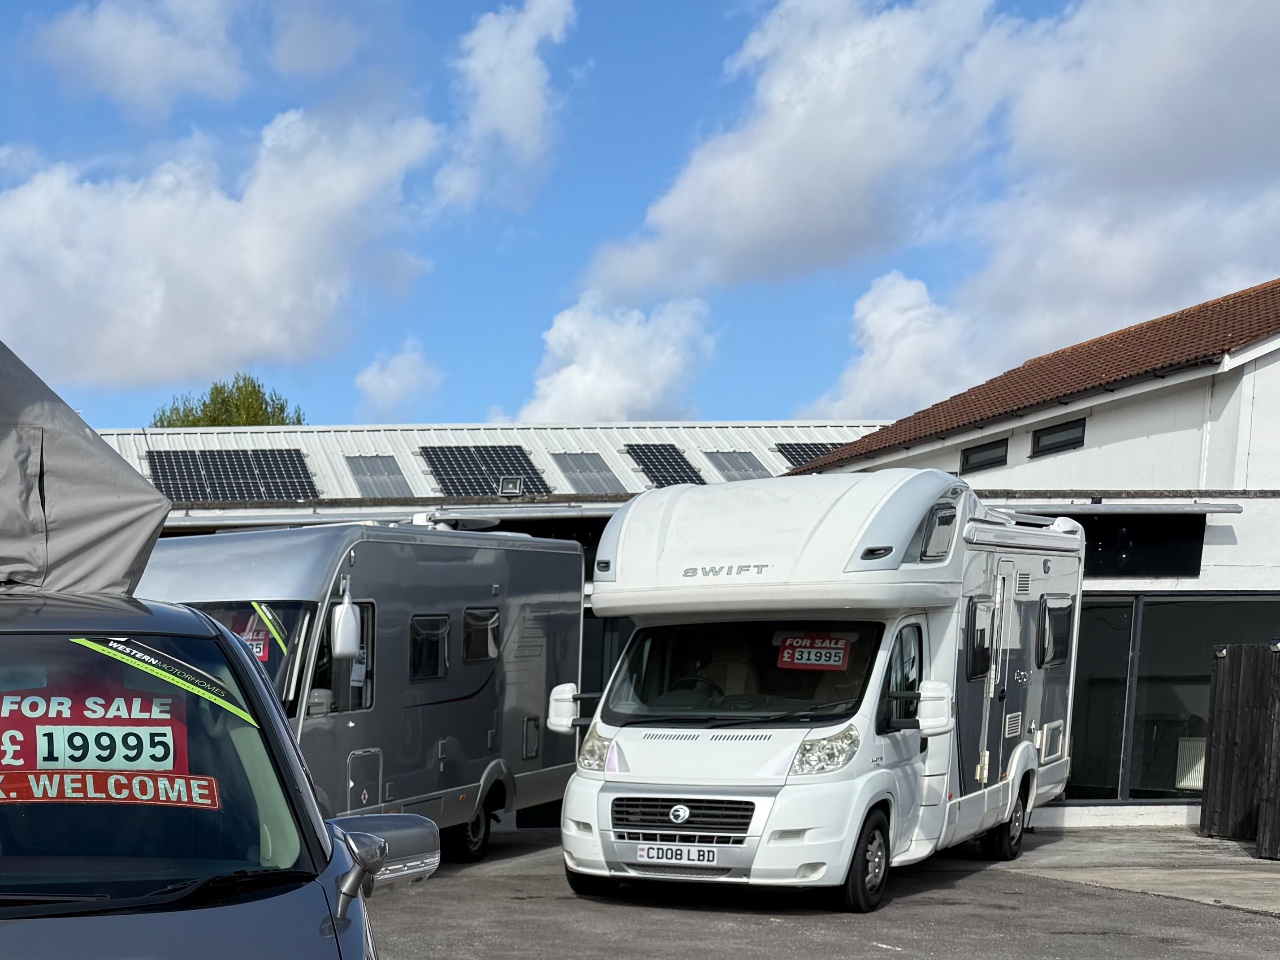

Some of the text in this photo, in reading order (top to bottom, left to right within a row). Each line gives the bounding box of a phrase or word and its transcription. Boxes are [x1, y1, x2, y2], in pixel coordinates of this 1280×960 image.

[682, 564, 769, 578] SWIFT
[785, 638, 847, 648] FOR SALE
[783, 649, 842, 663] £ 31995
[0, 695, 172, 720] FOR SALE
[0, 729, 172, 766] £ 19995
[28, 774, 212, 805] WELCOME
[646, 847, 715, 863] CD08 LBD
